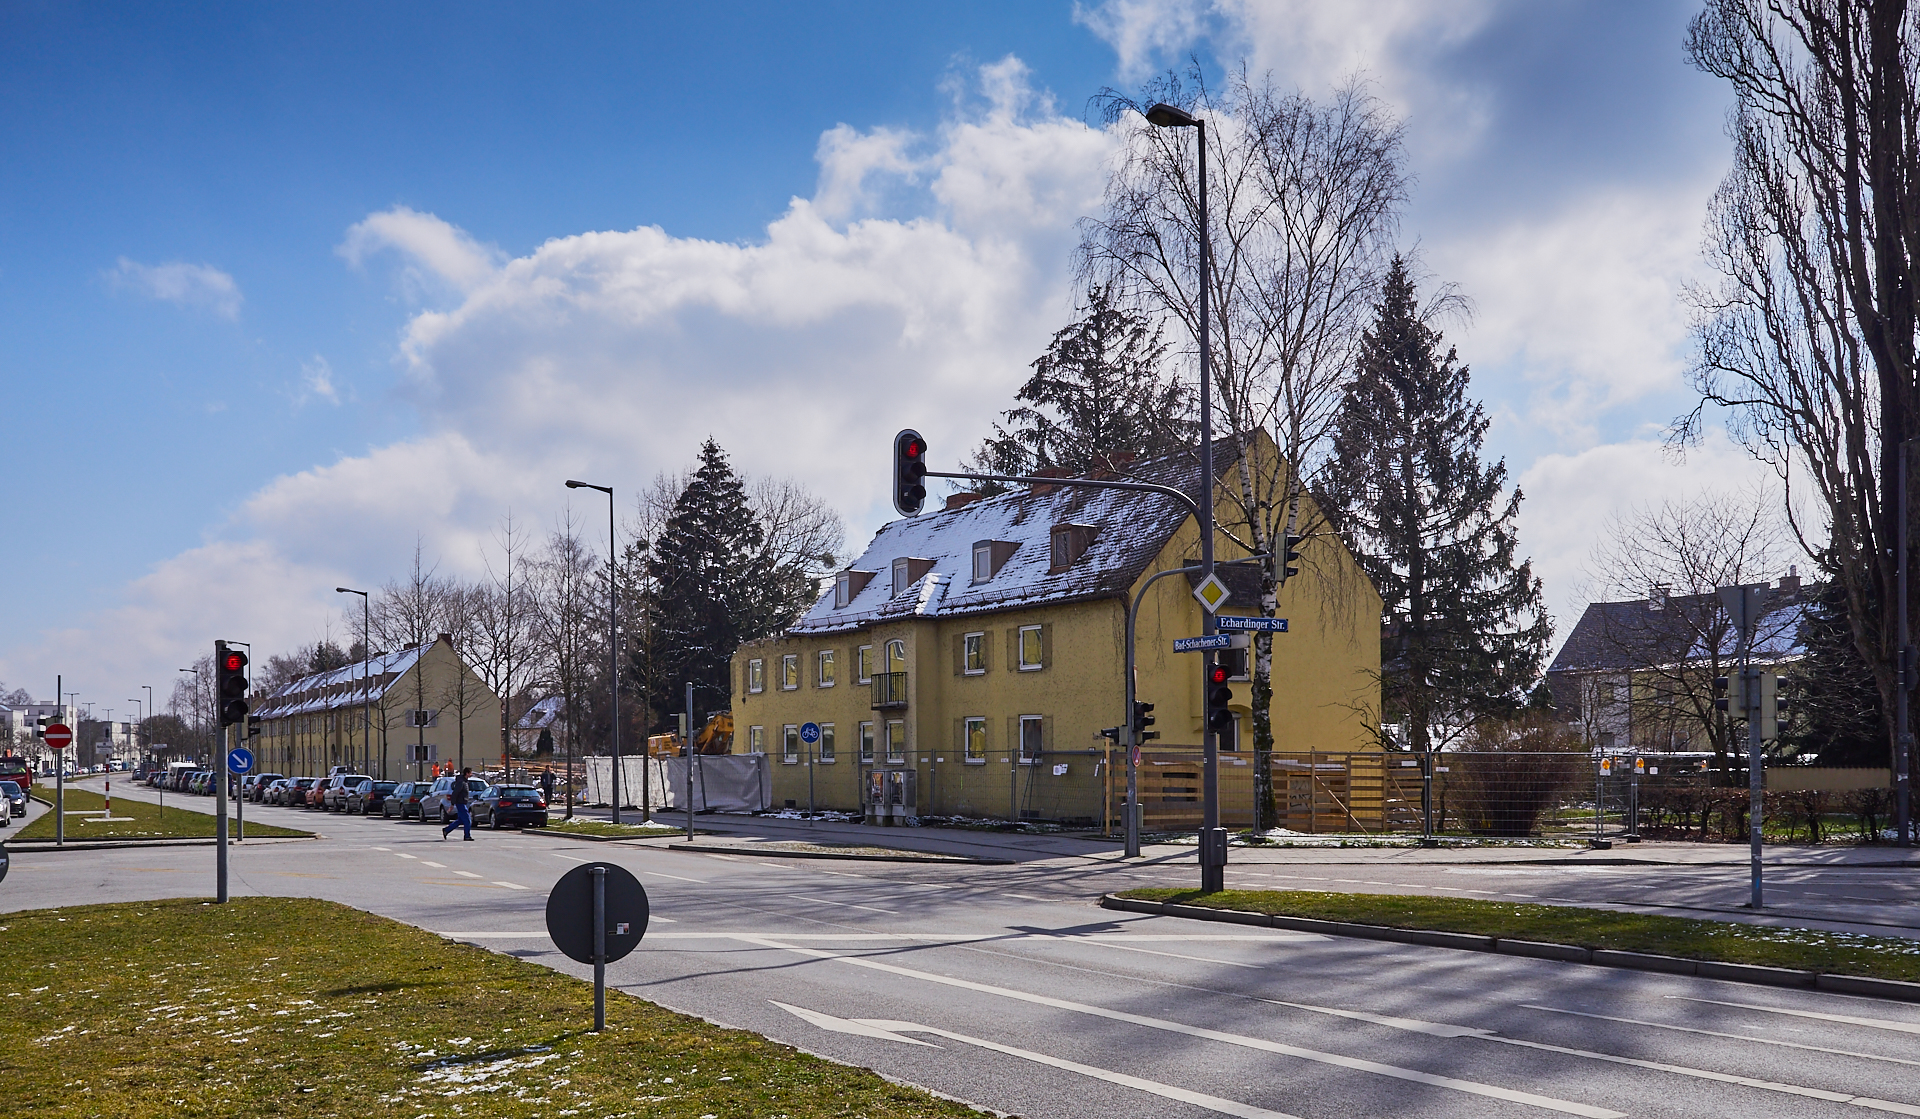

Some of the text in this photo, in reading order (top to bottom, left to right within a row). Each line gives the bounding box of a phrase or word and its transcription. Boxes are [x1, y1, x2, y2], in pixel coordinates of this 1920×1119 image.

[1220, 617, 1285, 630] Echardinger Str.
[1175, 636, 1228, 650] Bad-Schachener-Str.
